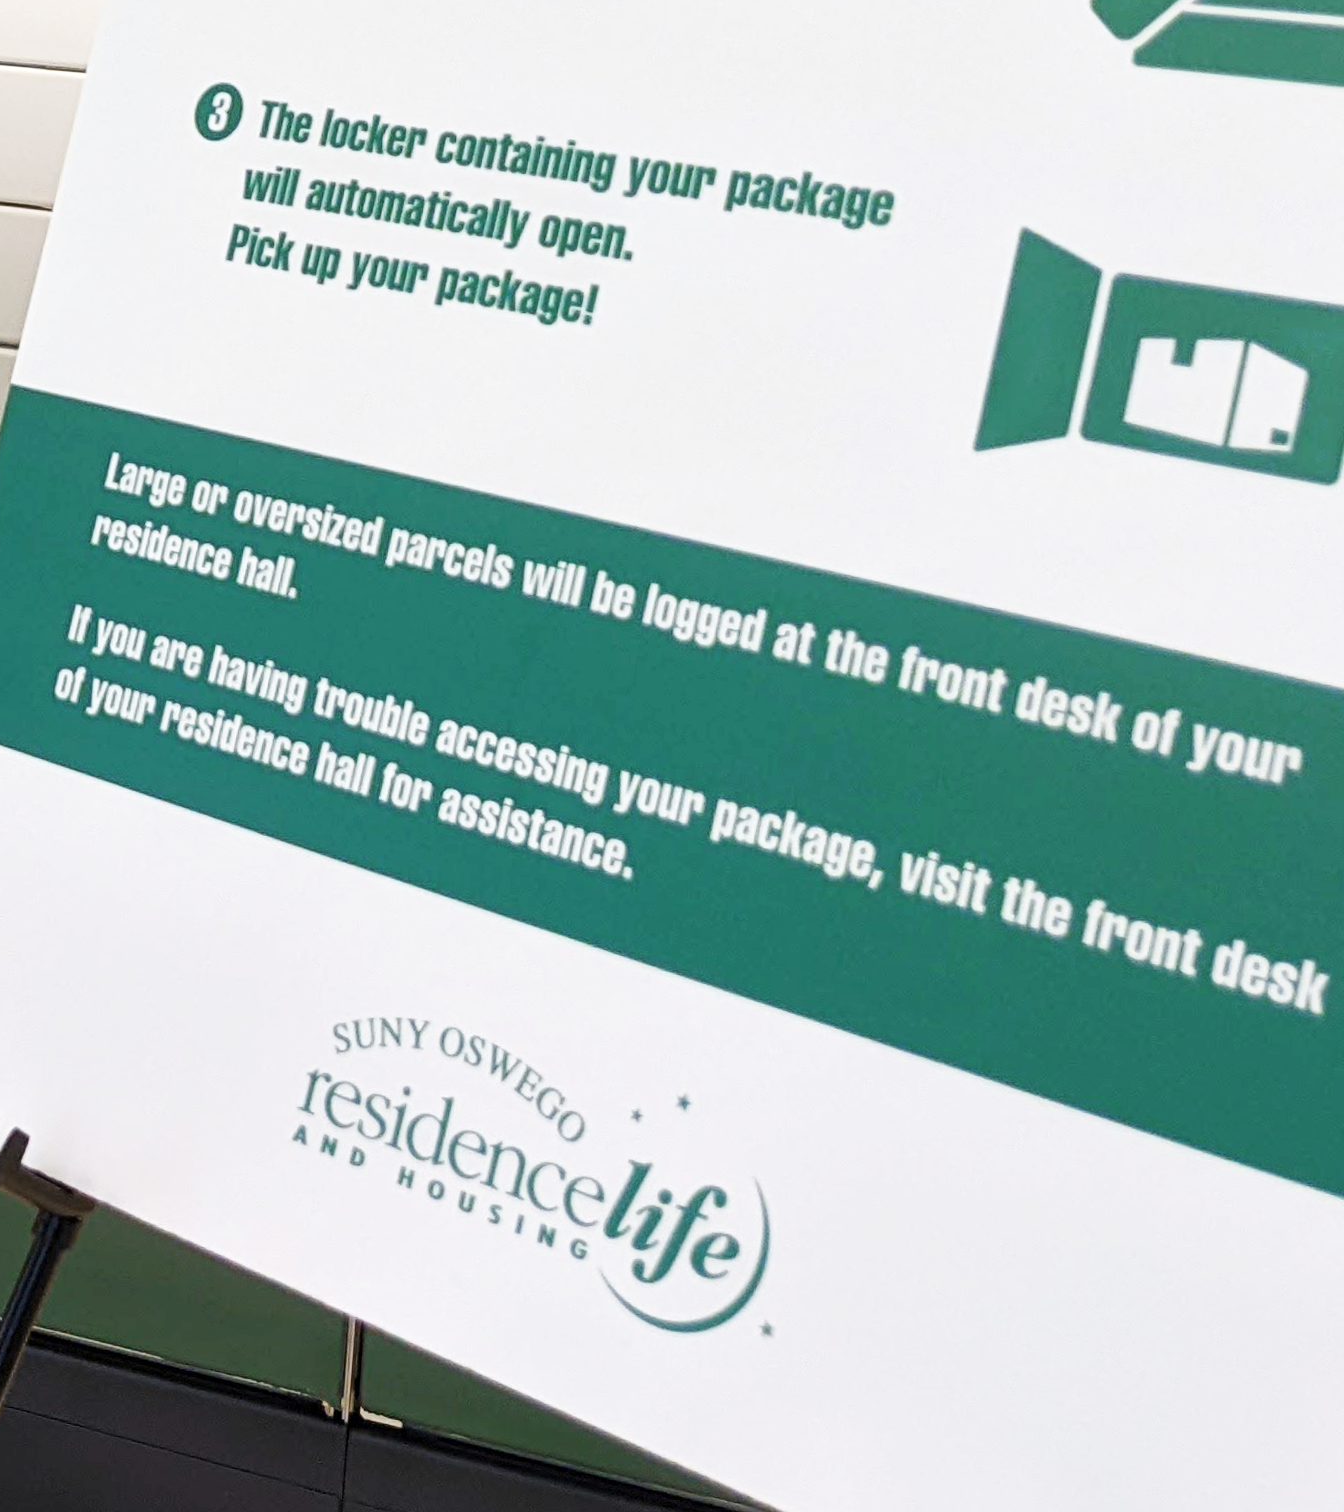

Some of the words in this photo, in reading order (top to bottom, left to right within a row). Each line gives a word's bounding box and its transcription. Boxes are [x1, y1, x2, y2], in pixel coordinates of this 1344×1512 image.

[207, 90, 233, 132] 3
[260, 101, 312, 143] The
[320, 109, 427, 158] locker
[436, 132, 616, 193] containing
[624, 157, 717, 199] your
[724, 171, 894, 229] package
[243, 167, 300, 206] will
[306, 180, 530, 249] automatically
[539, 215, 632, 260] open.
[226, 224, 294, 271] Pick
[301, 244, 341, 284] up
[347, 252, 429, 293] your
[435, 268, 599, 325] package!
[91, 516, 232, 579] residence
[237, 547, 297, 598] hall.
[105, 452, 186, 507] Large
[192, 481, 229, 514] or
[234, 491, 384, 555] oversized
[385, 528, 514, 588] parcels
[523, 561, 586, 607] will
[590, 571, 635, 619] be
[642, 583, 767, 652] logged
[773, 623, 816, 665] at
[825, 629, 889, 683] the
[899, 646, 1008, 713] front
[1015, 677, 1122, 743] desk
[1132, 709, 1181, 756] of
[1186, 724, 1302, 784] your
[55, 667, 86, 703] of
[86, 678, 156, 723] your
[160, 701, 309, 775] residence
[315, 742, 376, 796] hall
[379, 763, 433, 811] for
[438, 789, 632, 879] assistance.
[68, 605, 92, 643] If
[92, 619, 146, 660] you
[150, 636, 203, 677] are
[208, 645, 308, 715] having
[314, 678, 430, 745] trouble
[436, 720, 609, 805] accessing
[613, 771, 705, 825] your
[710, 799, 883, 889] package,
[901, 852, 992, 915] visit
[1001, 877, 1073, 938] the
[1082, 900, 1203, 977] front
[1211, 940, 1329, 1014] desk
[334, 1018, 428, 1053] SUNY
[440, 1028, 584, 1142] OSWEGO
[293, 1125, 365, 1166] AND
[398, 1163, 589, 1259] HOUSING
